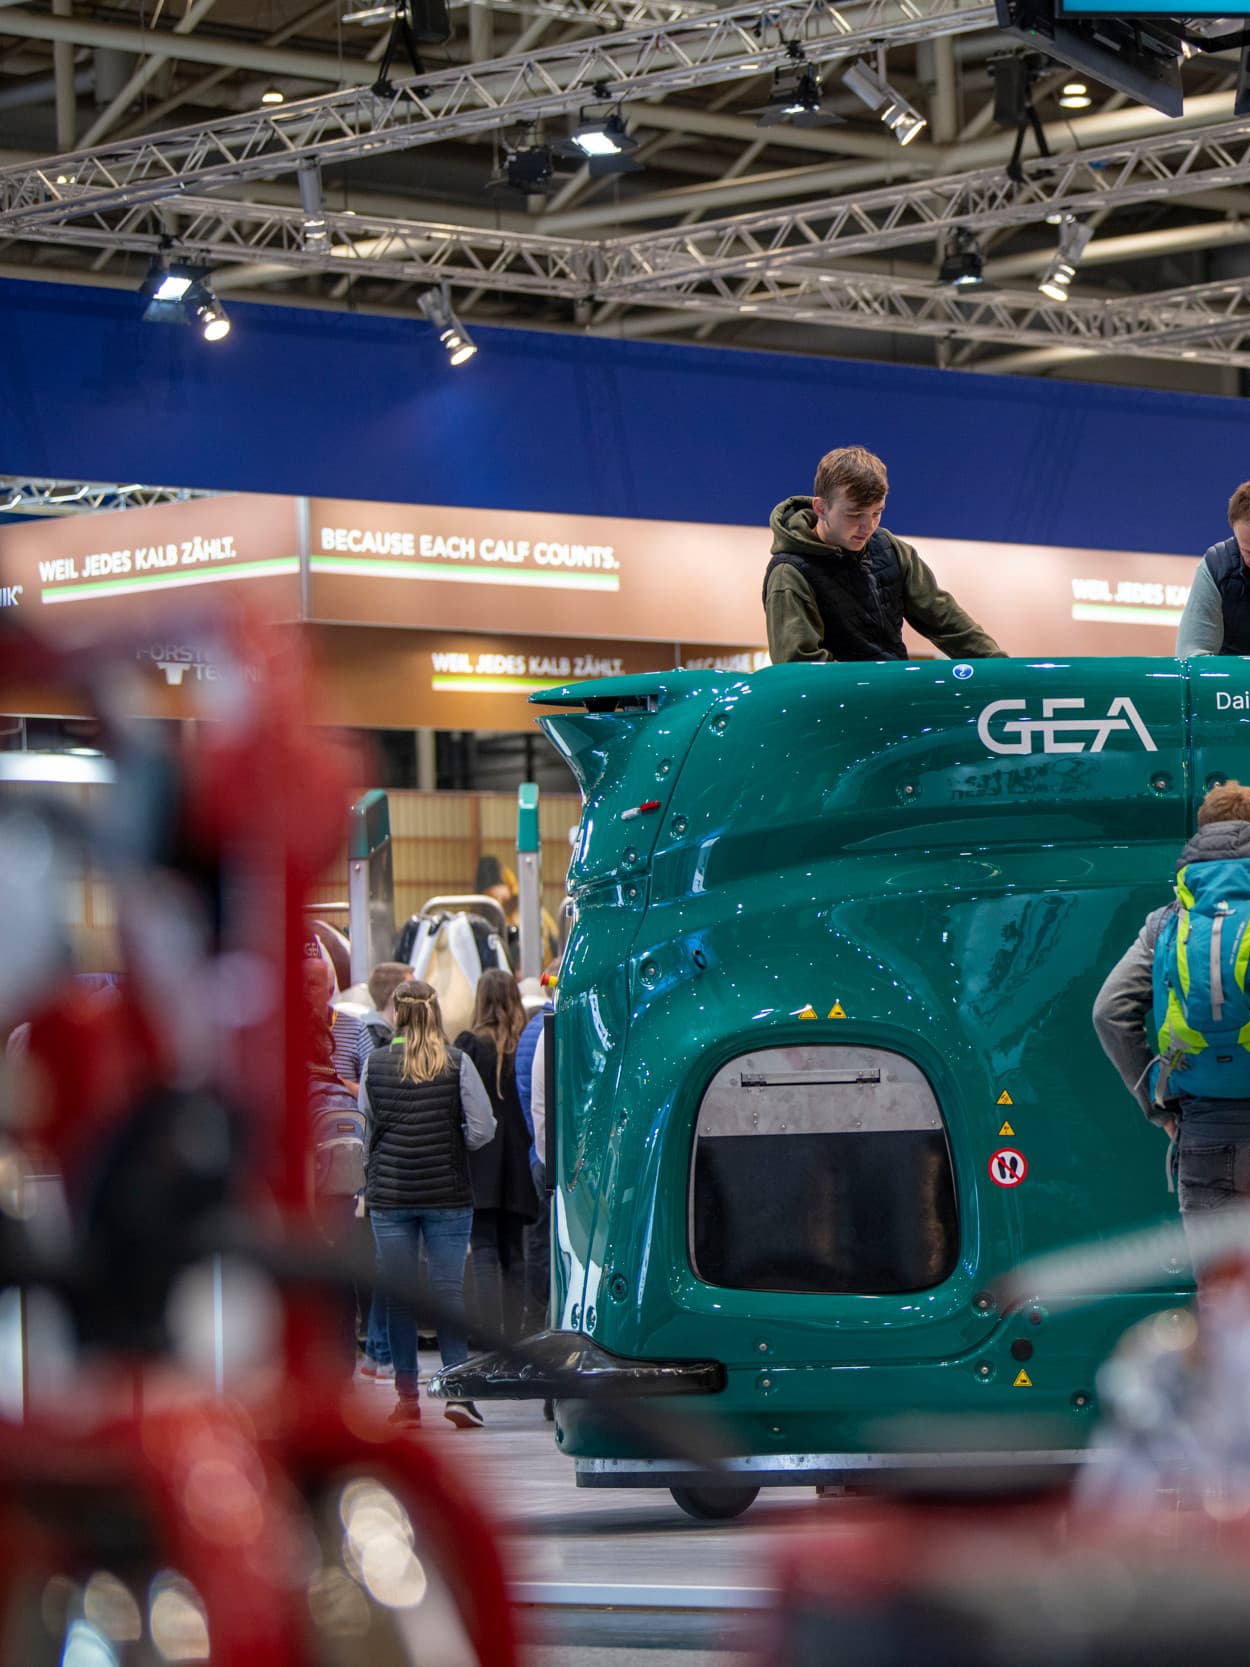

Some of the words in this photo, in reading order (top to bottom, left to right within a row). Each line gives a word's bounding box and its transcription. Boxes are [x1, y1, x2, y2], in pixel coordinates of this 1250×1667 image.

[38, 560, 79, 582] WEIL
[82, 550, 132, 578] JEDES
[135, 543, 178, 570] KALB
[181, 536, 236, 565] ZÄHLT.
[321, 527, 416, 556] BECAUSE
[419, 534, 475, 560] EACH
[479, 538, 530, 563] CALF
[534, 542, 620, 569] COUNTS.
[431, 652, 473, 673] WEIL
[475, 654, 526, 675] JEDES
[528, 656, 571, 676] KALB
[977, 697, 1159, 755] GEA
